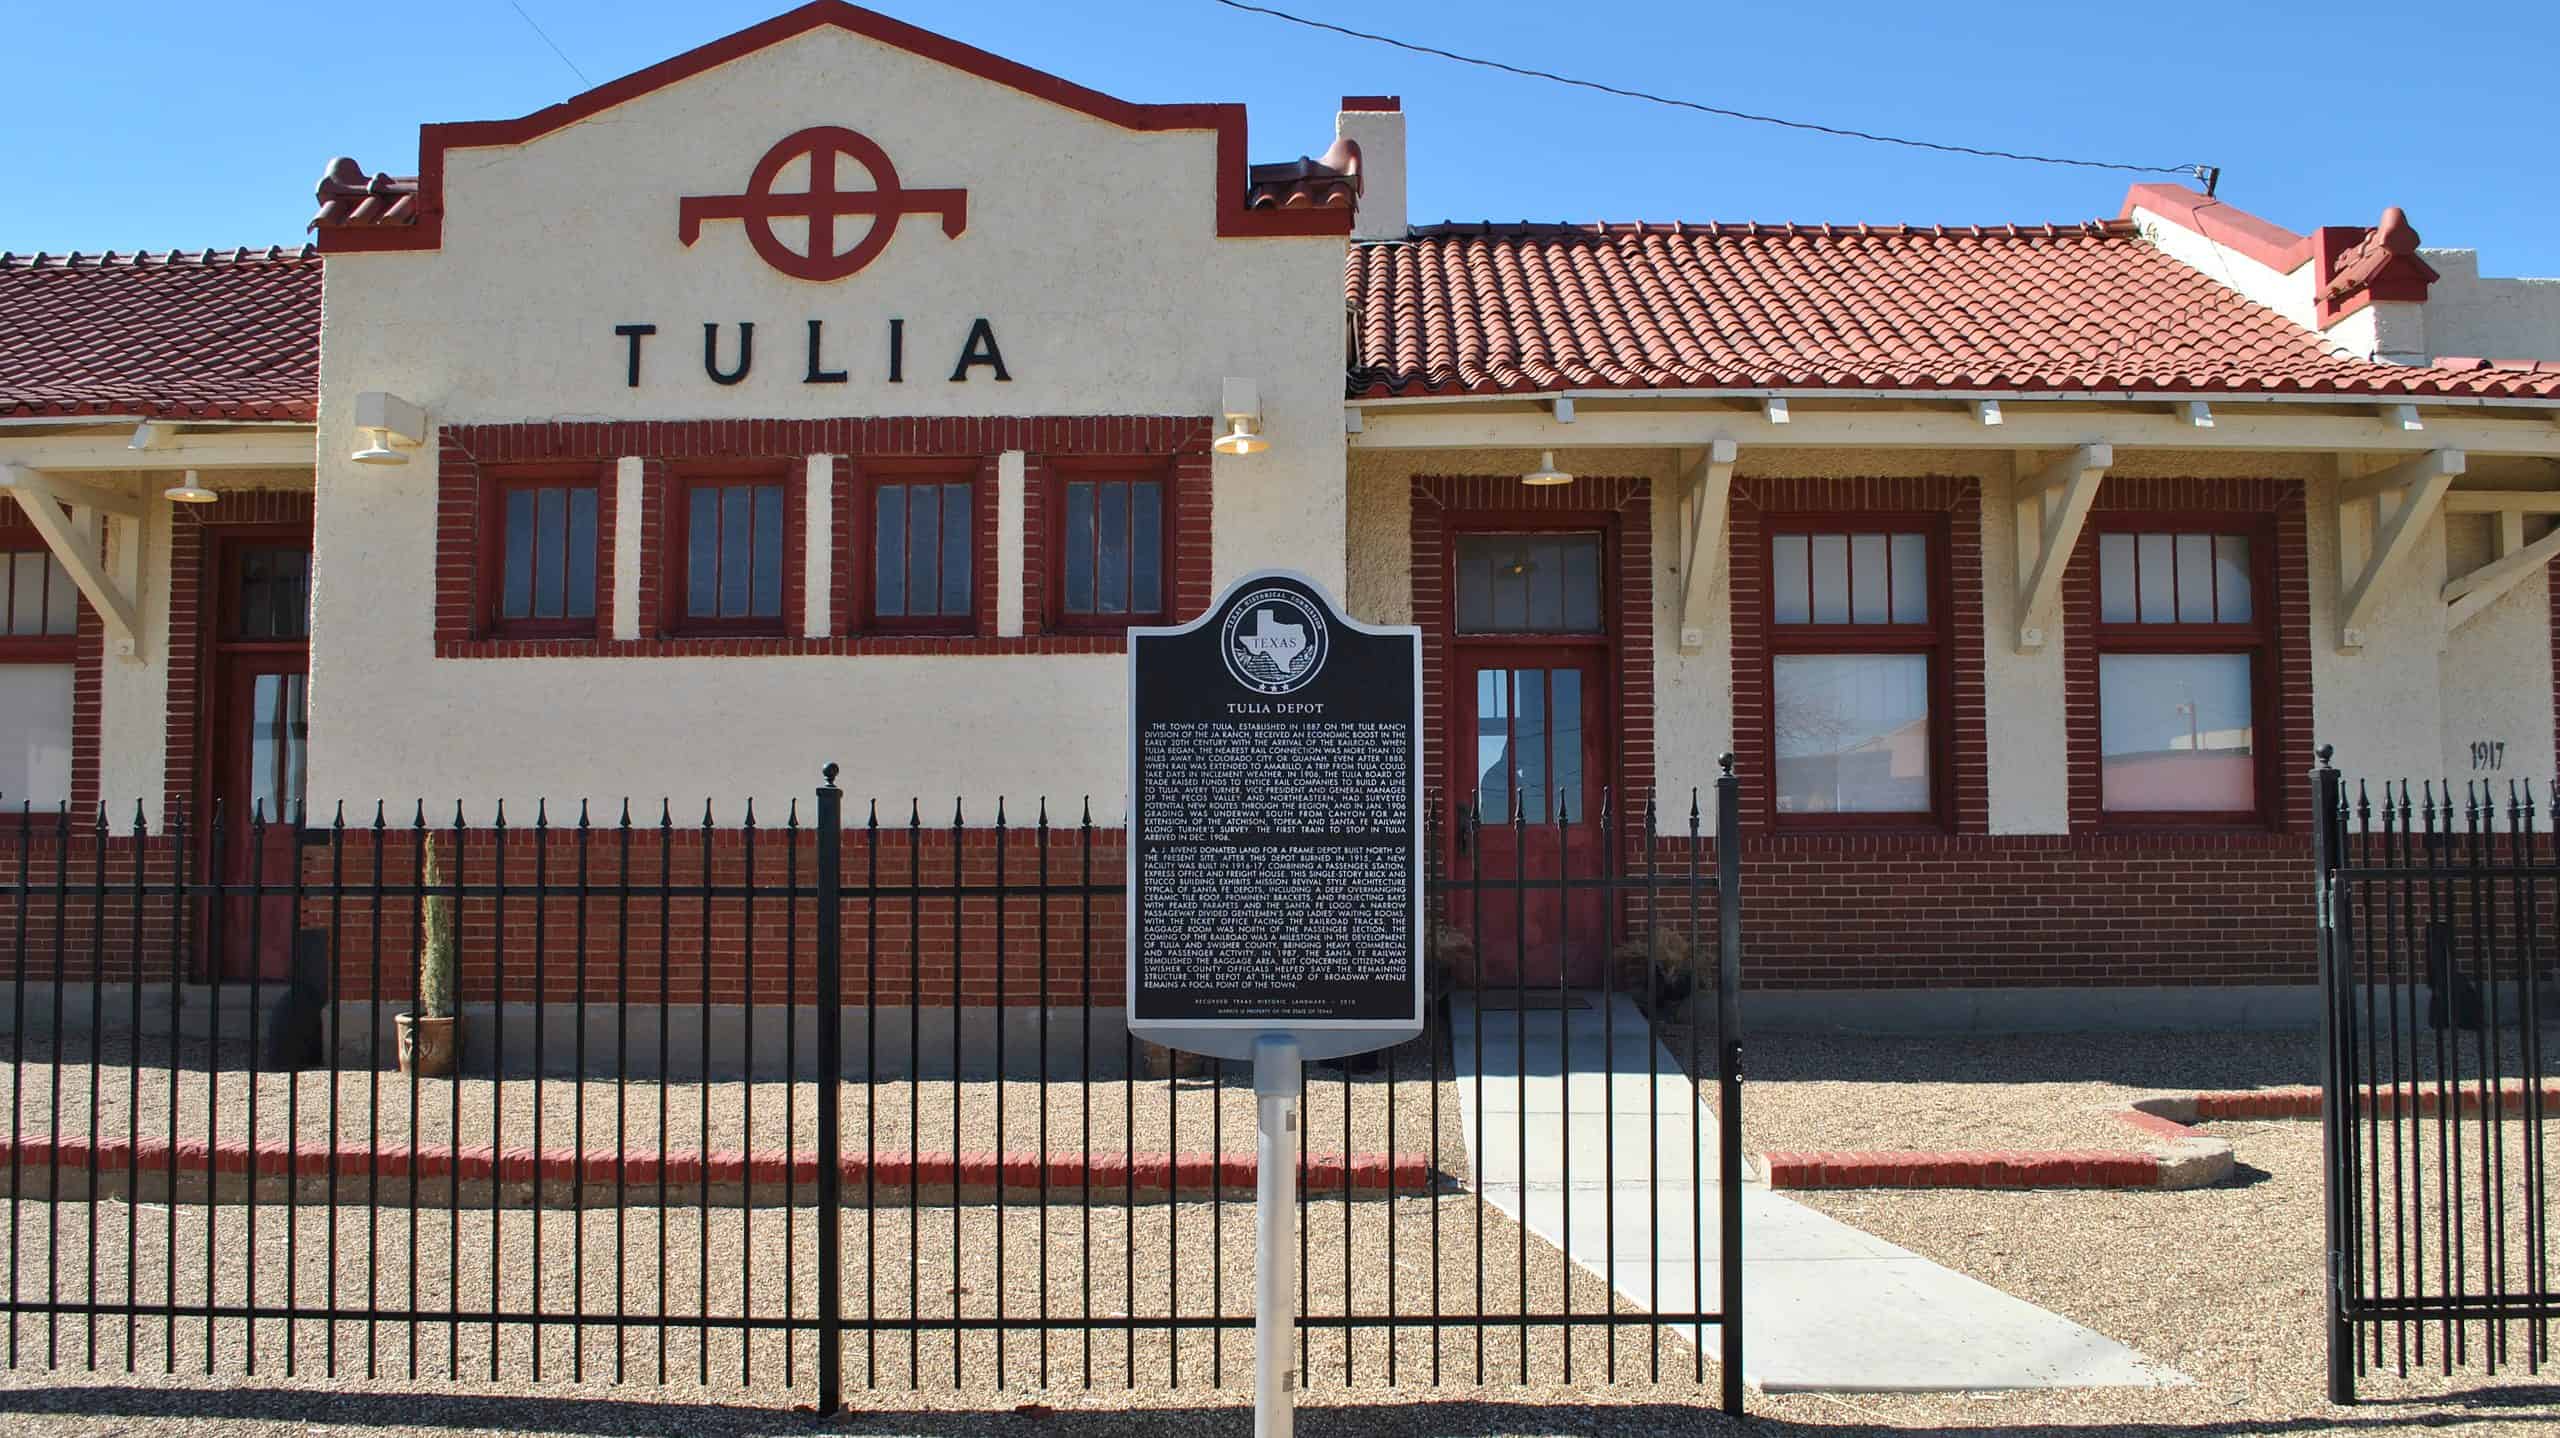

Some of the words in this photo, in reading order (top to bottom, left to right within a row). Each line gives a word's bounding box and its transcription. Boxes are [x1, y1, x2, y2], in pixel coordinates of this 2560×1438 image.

[615, 318, 1012, 387] TULIA
[1254, 637, 1297, 649] TEXAS
[1226, 703, 1271, 714] TULIA
[1277, 703, 1325, 714] DEPOT
[2470, 740, 2505, 770] 1917
